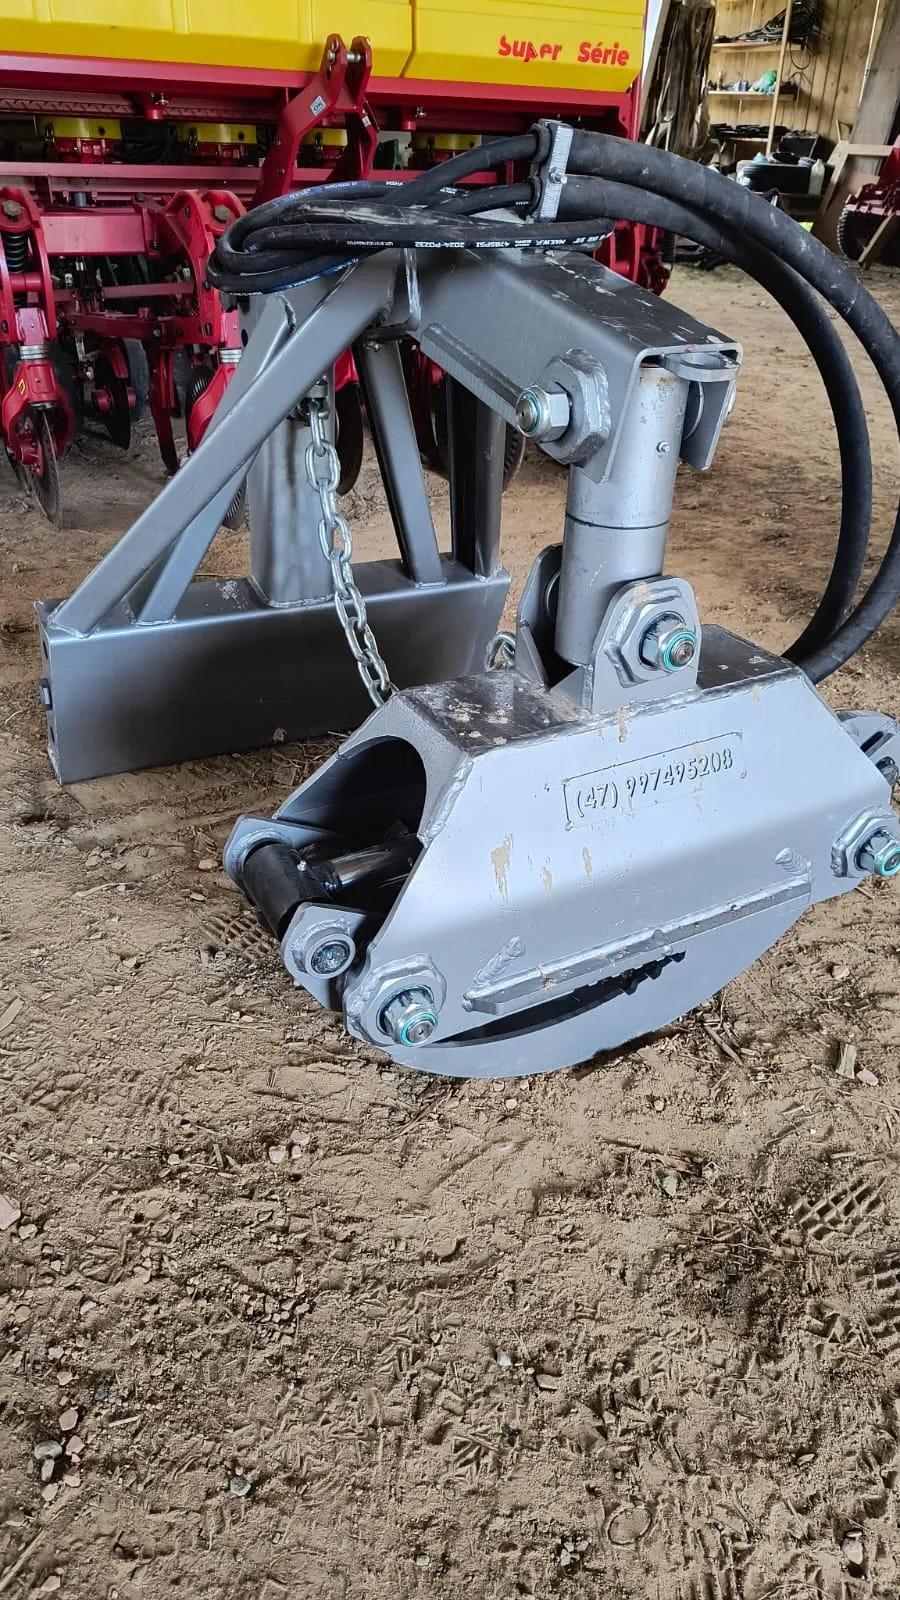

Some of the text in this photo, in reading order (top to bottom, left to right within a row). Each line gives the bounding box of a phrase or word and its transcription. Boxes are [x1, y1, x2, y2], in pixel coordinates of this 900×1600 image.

[498, 35, 630, 66] Super Série
[313, 100, 323, 111] OK
[577, 747, 733, 818] (47) 997495208
